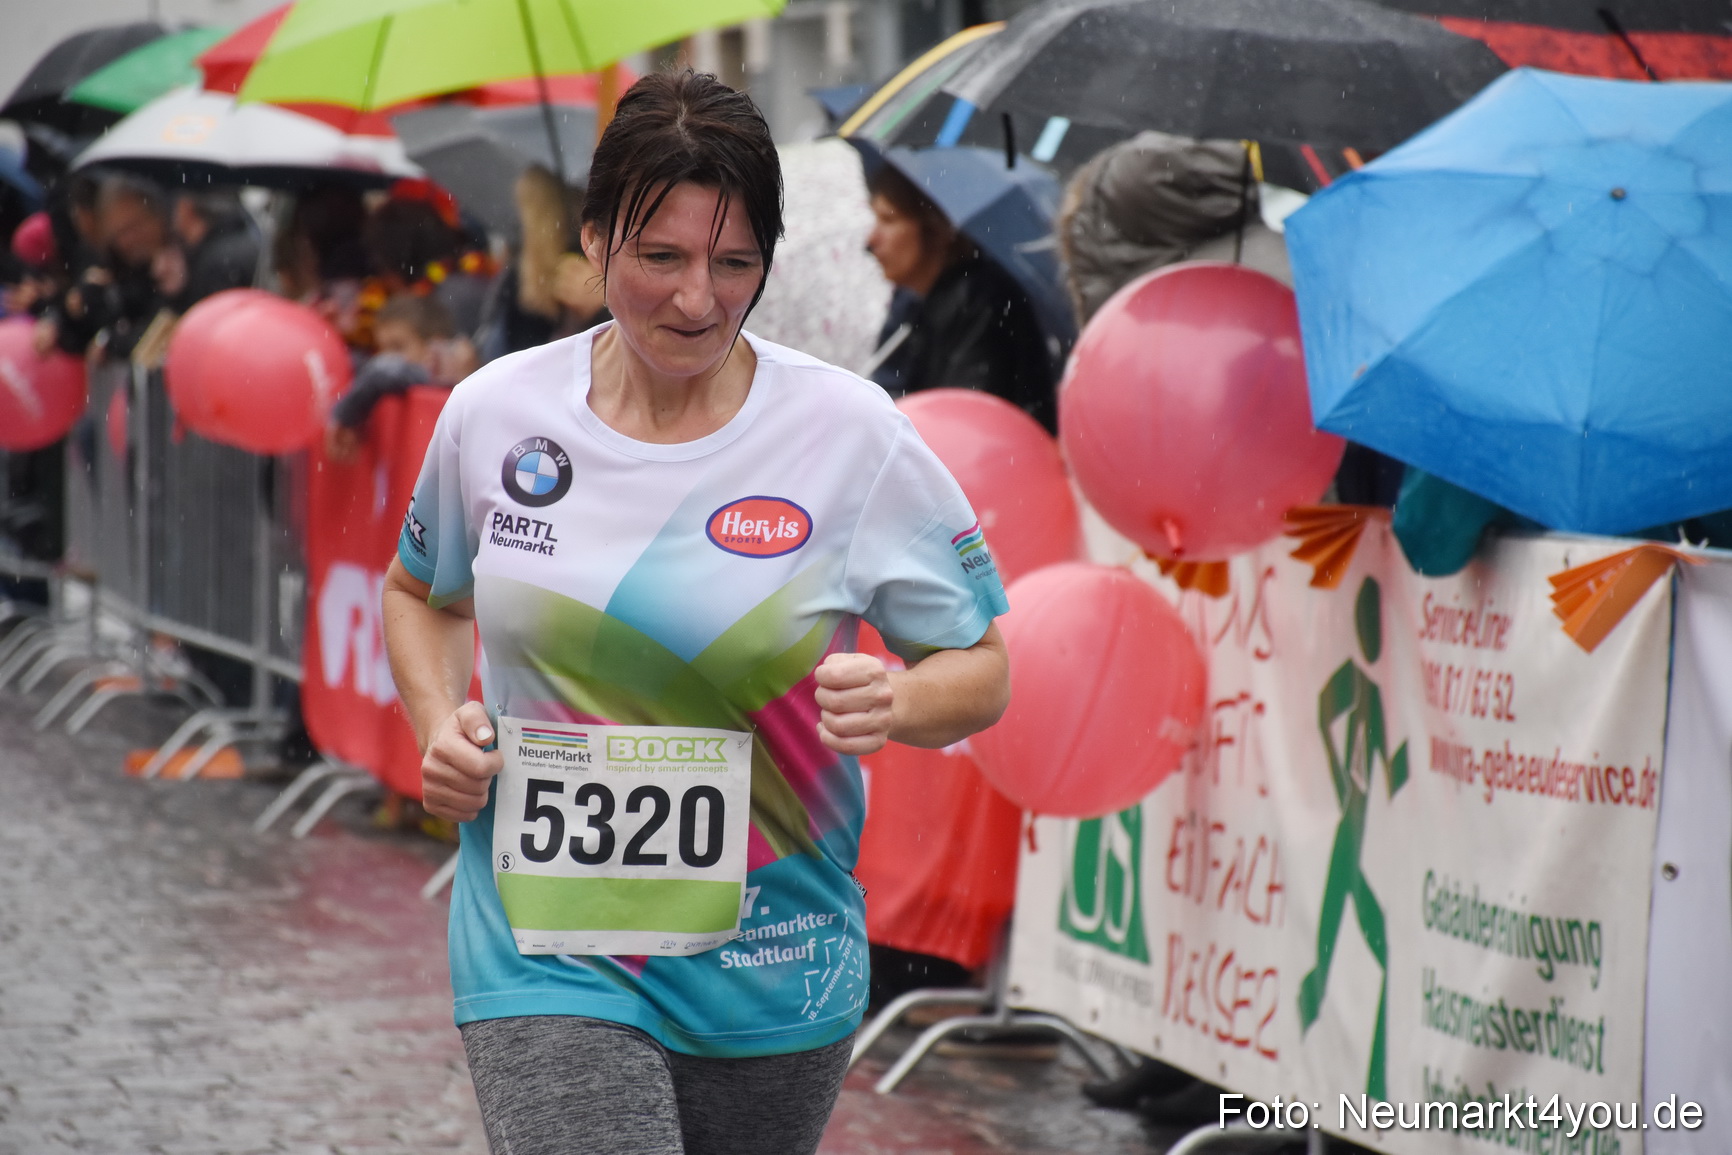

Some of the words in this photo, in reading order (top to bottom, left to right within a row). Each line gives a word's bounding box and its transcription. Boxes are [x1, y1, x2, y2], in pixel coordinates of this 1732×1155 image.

[511, 438, 570, 468] BMW
[492, 512, 558, 543] PARTL
[721, 511, 799, 543] Hervis
[724, 536, 762, 544] SPORTS
[489, 531, 555, 556] Neumarkt
[961, 549, 992, 575] Neu
[518, 745, 592, 763] NeuerMarkt
[606, 735, 728, 763] BOCK
[606, 763, 642, 773] inspired
[645, 764, 655, 774] by
[658, 765, 685, 773] smart
[687, 765, 729, 774] concepts
[520, 778, 725, 868] 5320
[737, 912, 838, 942] eumarkter
[720, 937, 817, 969] Stadtlauf
[807, 1008, 820, 1021] 18.
[815, 958, 846, 1009] September
